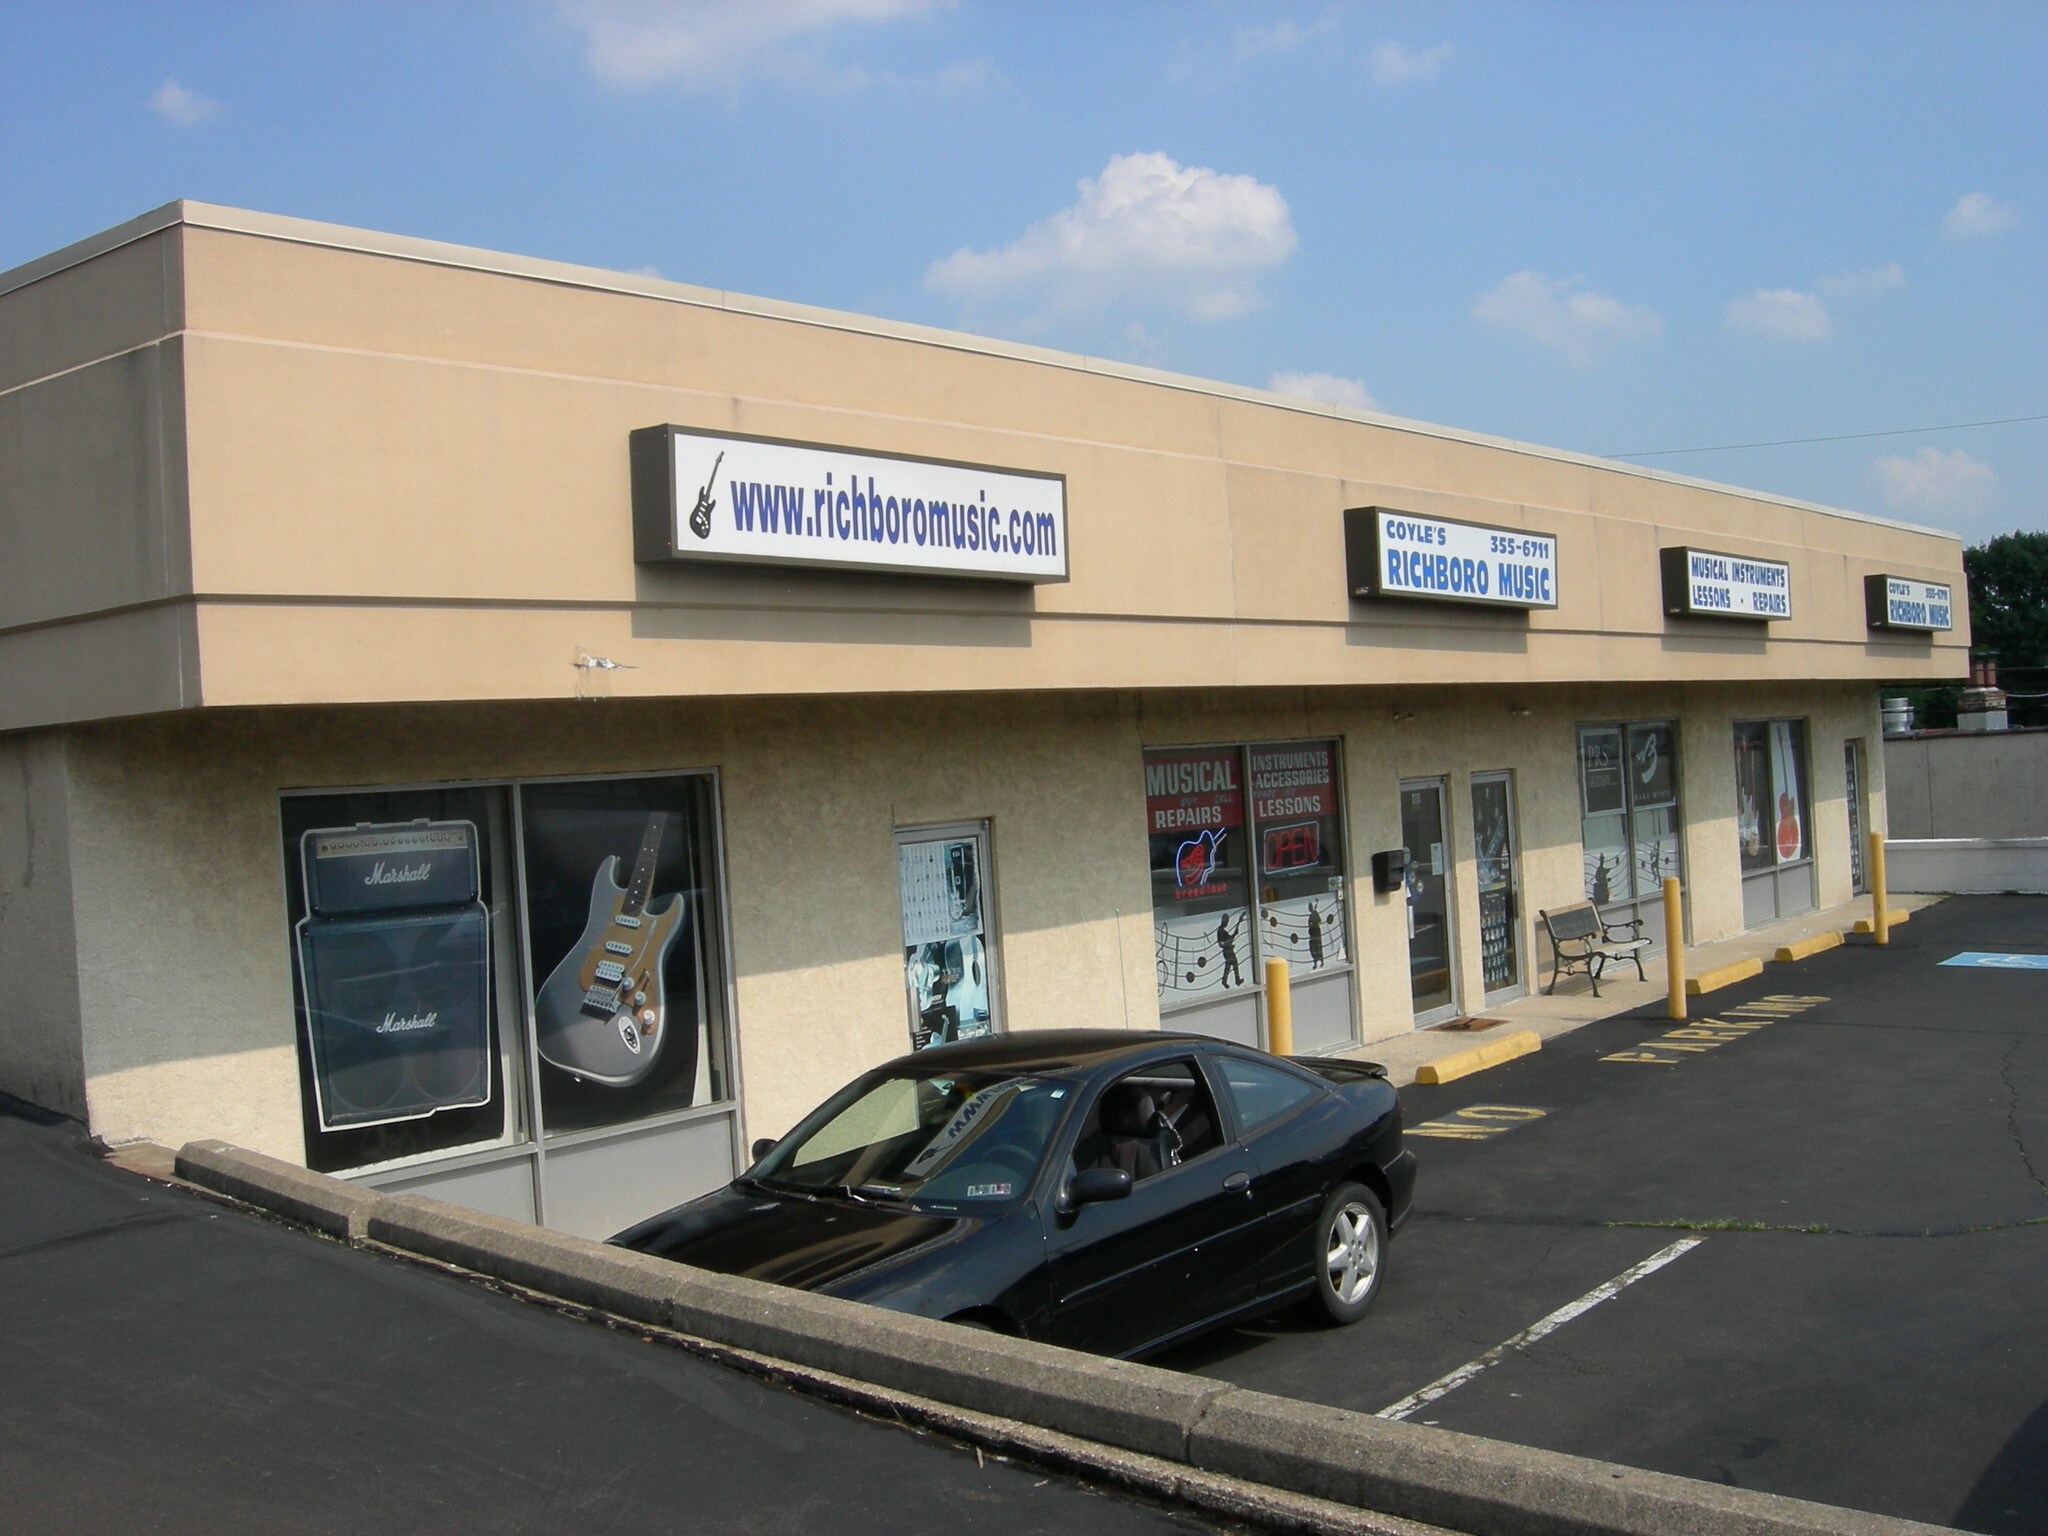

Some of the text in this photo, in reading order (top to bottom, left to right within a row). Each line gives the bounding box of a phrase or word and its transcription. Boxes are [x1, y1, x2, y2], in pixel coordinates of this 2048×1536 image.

[731, 472, 1057, 556] www.richboromusic.com
[1386, 519, 1549, 559] COYLE'S 355-6711
[1387, 549, 1550, 601] RICHBORO MUSIC
[1691, 556, 1785, 588] MUSICAL INSTRUMENTS
[1693, 585, 1787, 614] LESSONS REPAIRS
[1253, 750, 1328, 771] INSTRUMENTS
[1148, 759, 1237, 797] MUSICAL
[1255, 768, 1330, 789] ACCESSORIES
[1155, 805, 1222, 829] REPAIRS
[1259, 795, 1321, 818] LESSONS
[1266, 826, 1318, 869] OPEN
[364, 861, 431, 886] Marshall
[376, 1012, 438, 1035] Marshall
[1402, 994, 1832, 1141] NO PARKING
